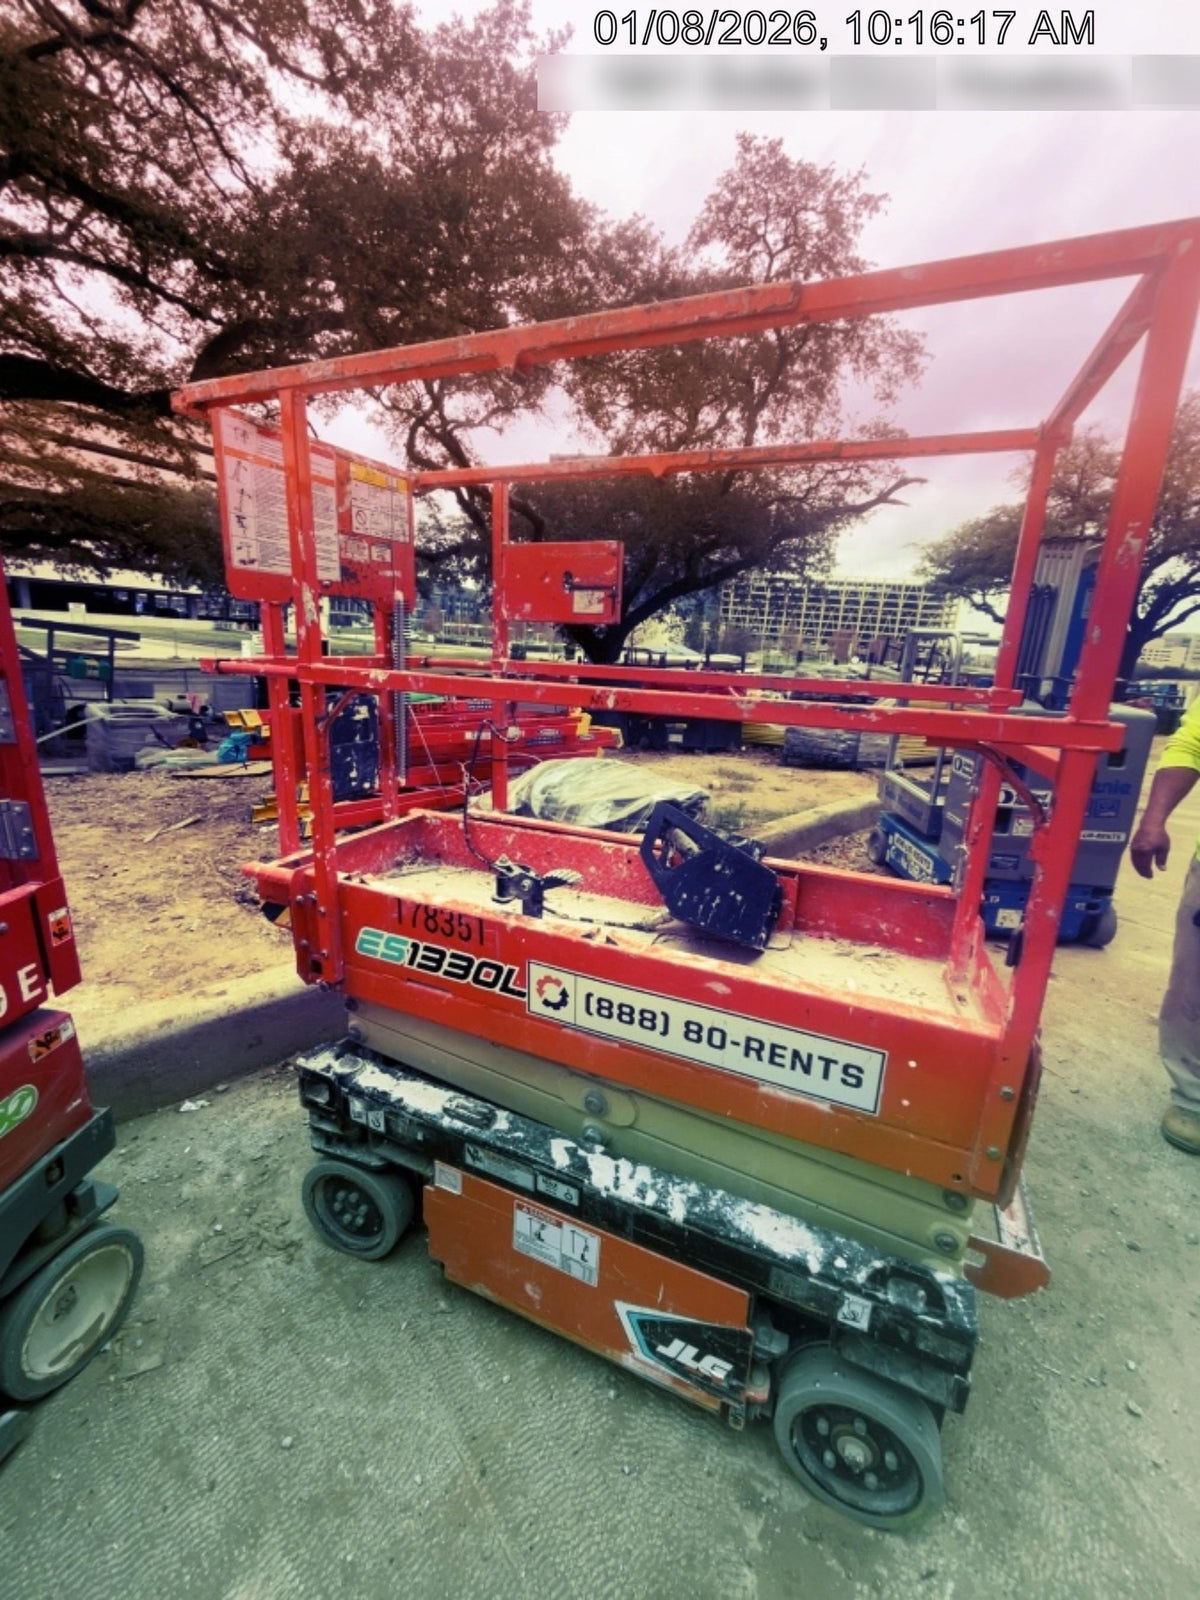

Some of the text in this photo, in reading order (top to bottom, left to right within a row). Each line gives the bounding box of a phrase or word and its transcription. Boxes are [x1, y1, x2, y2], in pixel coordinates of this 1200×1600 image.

[356, 926, 528, 999] ES1330L
[583, 991, 866, 1090] (888) 80-RENTS
[656, 1338, 734, 1381] JLG
